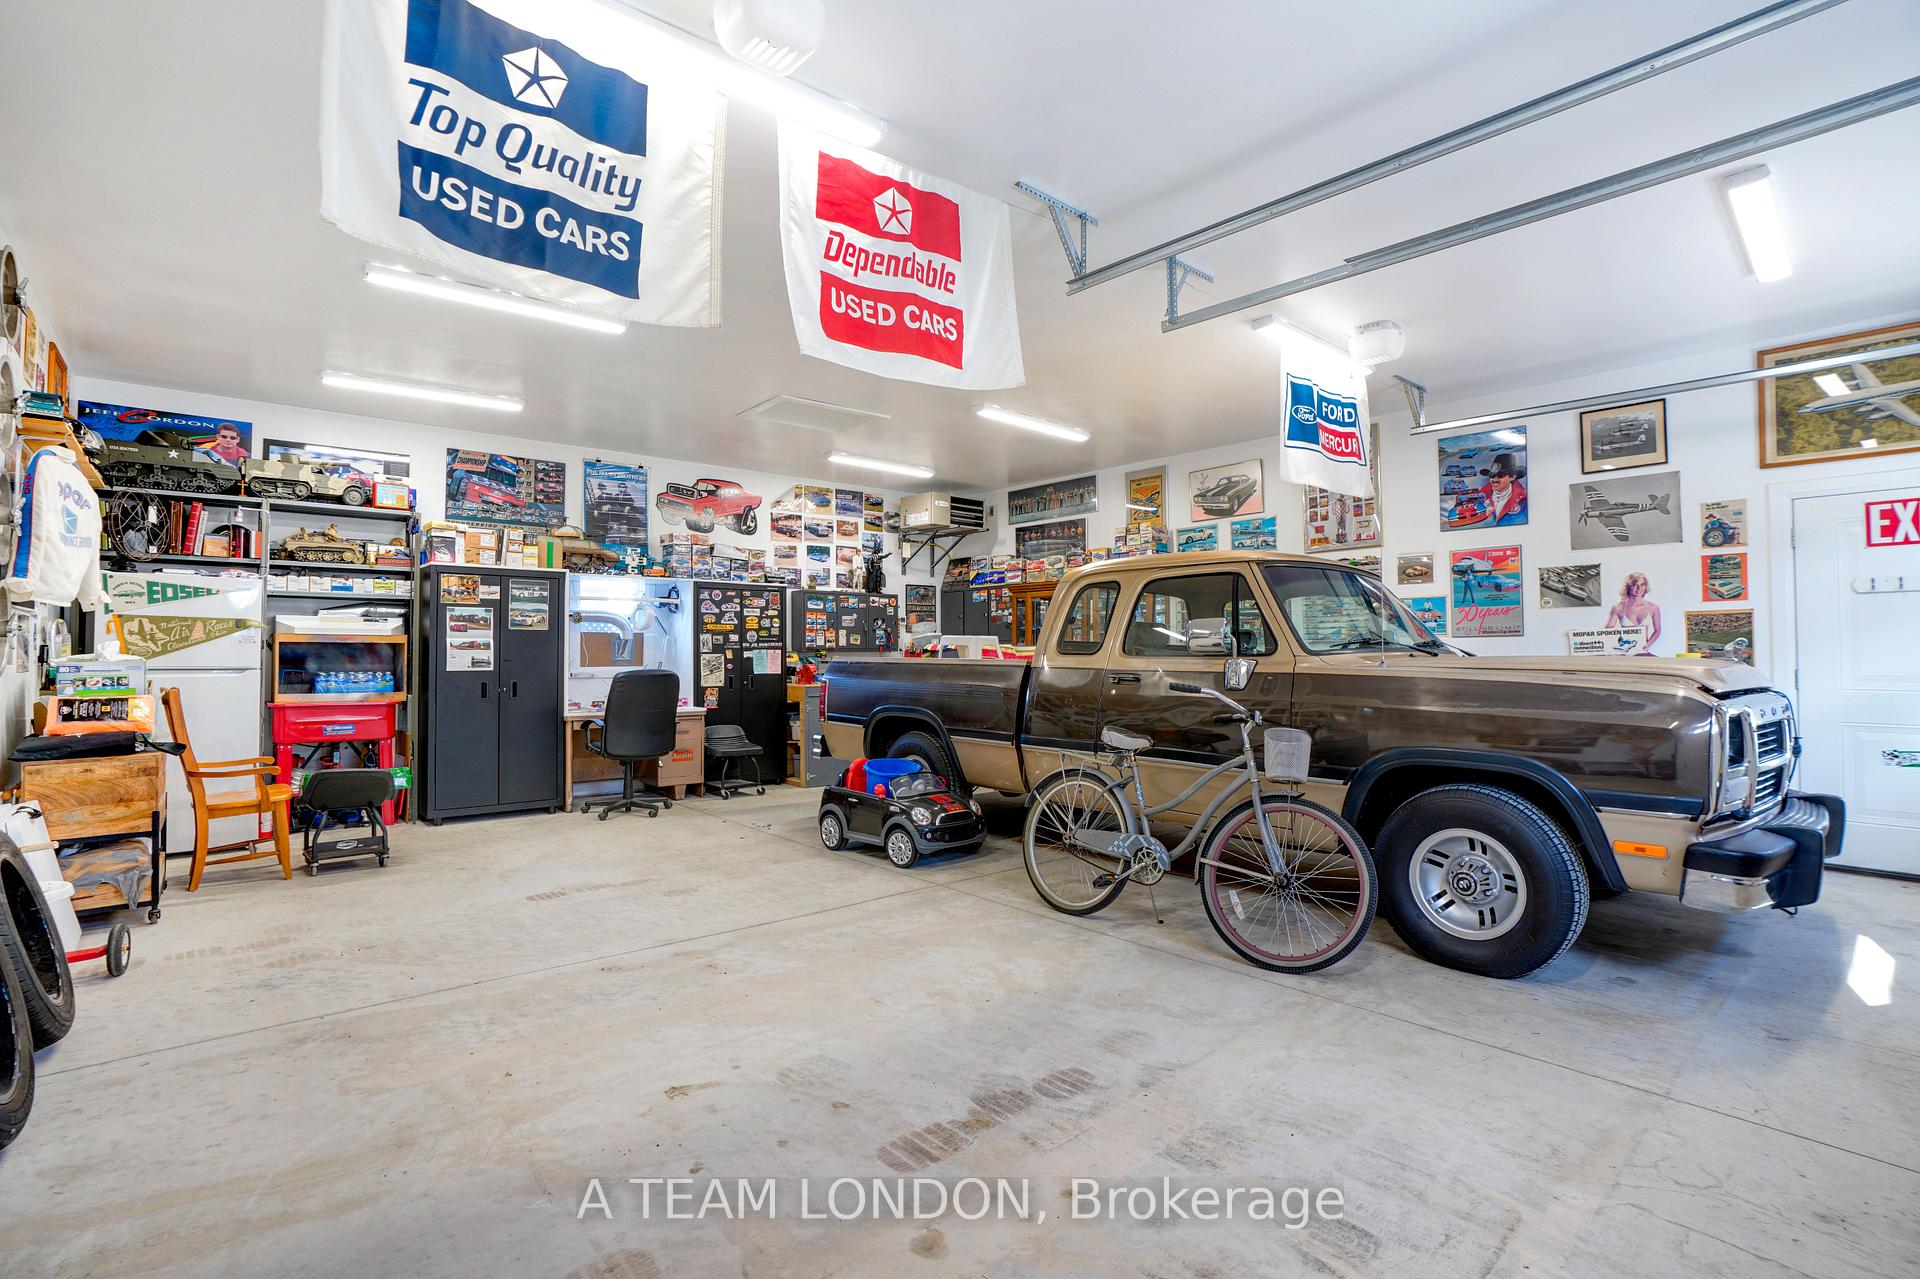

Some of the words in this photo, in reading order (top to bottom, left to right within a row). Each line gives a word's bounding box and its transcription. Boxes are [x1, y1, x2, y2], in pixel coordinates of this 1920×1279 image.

[408, 78, 487, 156] Top
[495, 122, 642, 211] Quality
[412, 166, 525, 230] USED
[535, 207, 630, 262] CARS
[823, 230, 956, 294] Dependable
[831, 287, 896, 326] USED
[903, 305, 958, 341] CARS
[1297, 407, 1314, 421] Ford
[1322, 402, 1355, 422] FORD
[1319, 429, 1359, 455] MERCUR
[1869, 501, 1920, 544] EX
[1456, 604, 1479, 626] 30
